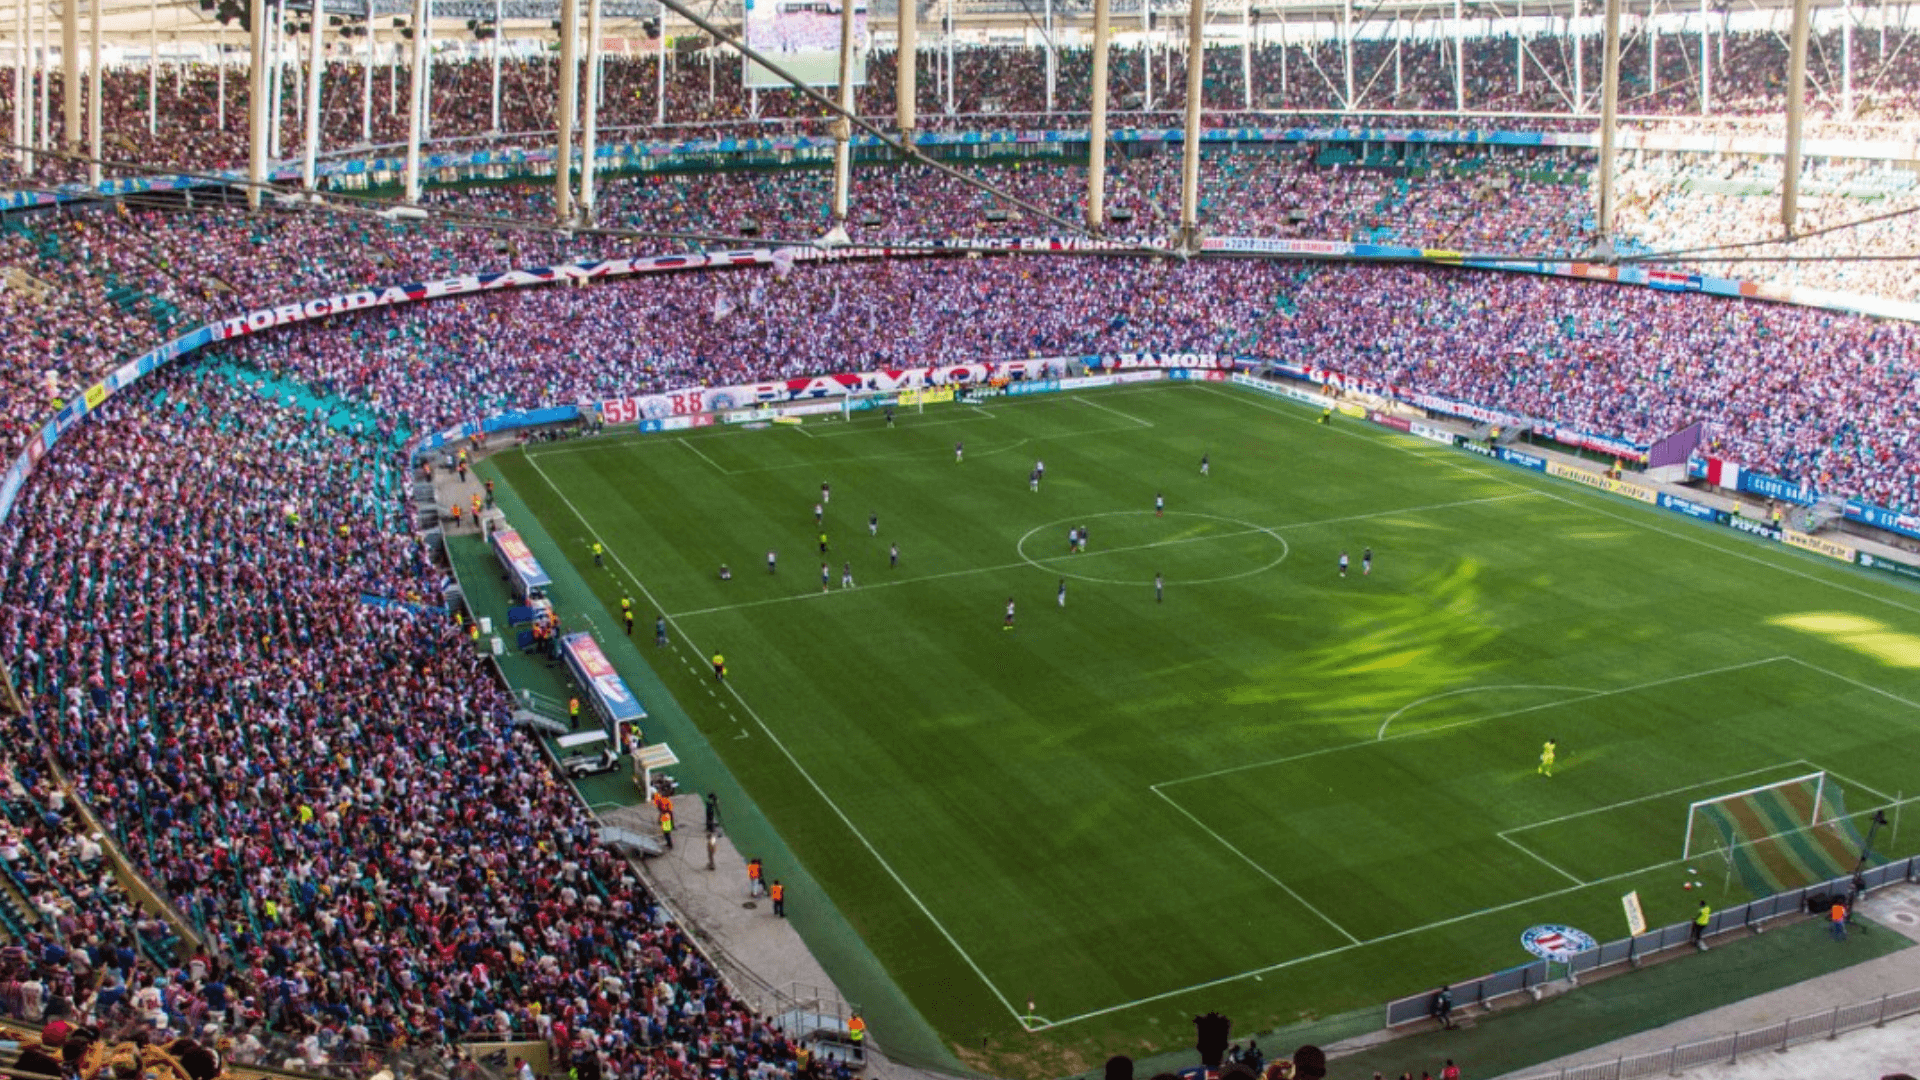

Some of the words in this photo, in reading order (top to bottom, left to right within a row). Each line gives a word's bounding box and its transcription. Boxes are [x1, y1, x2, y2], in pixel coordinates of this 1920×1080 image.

[1021, 236, 1050, 250] EM
[225, 286, 409, 334] TORCIDA
[1120, 353, 1218, 368] BAMOR
[604, 397, 637, 424] 59
